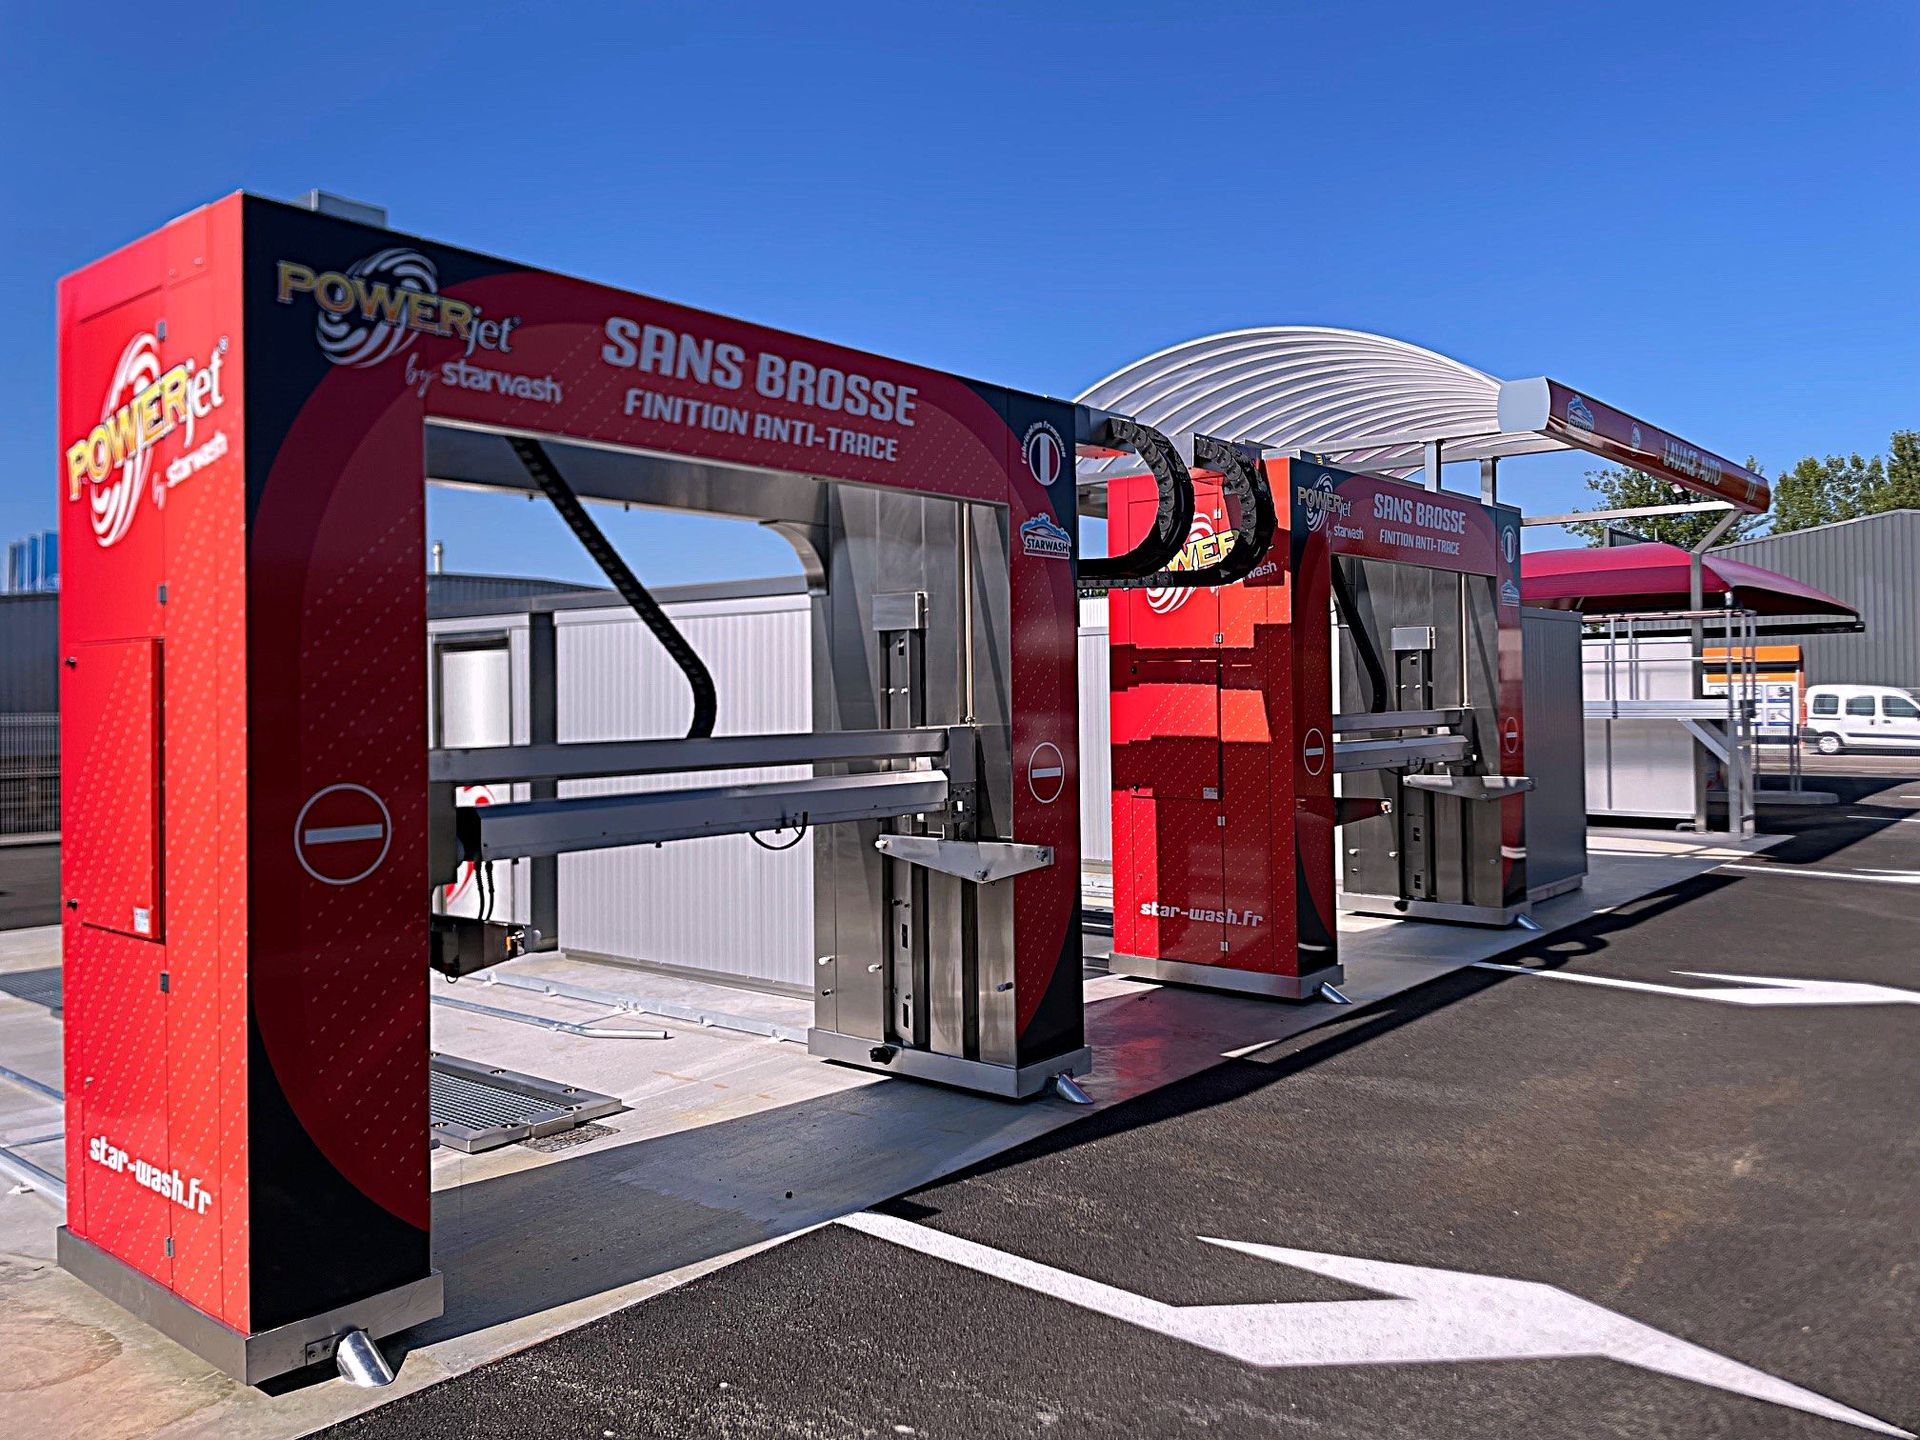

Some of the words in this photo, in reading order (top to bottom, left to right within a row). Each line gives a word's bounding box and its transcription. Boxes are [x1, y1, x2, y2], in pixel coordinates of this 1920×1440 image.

[441, 359, 562, 404] starwash
[602, 316, 745, 391] SANS
[755, 352, 918, 427] BROSSE
[625, 387, 750, 436] FINITION
[753, 414, 899, 463] ANTI-TRACE
[1373, 493, 1413, 524] SANS
[1415, 501, 1466, 535] BROSSE
[1026, 538, 1069, 552] STARWASH
[1379, 528, 1414, 548] FINITION
[1415, 534, 1460, 556] ANTI-TRACE
[1140, 901, 1263, 928] star-wash.fr
[89, 1135, 213, 1215] star-wash.fr
